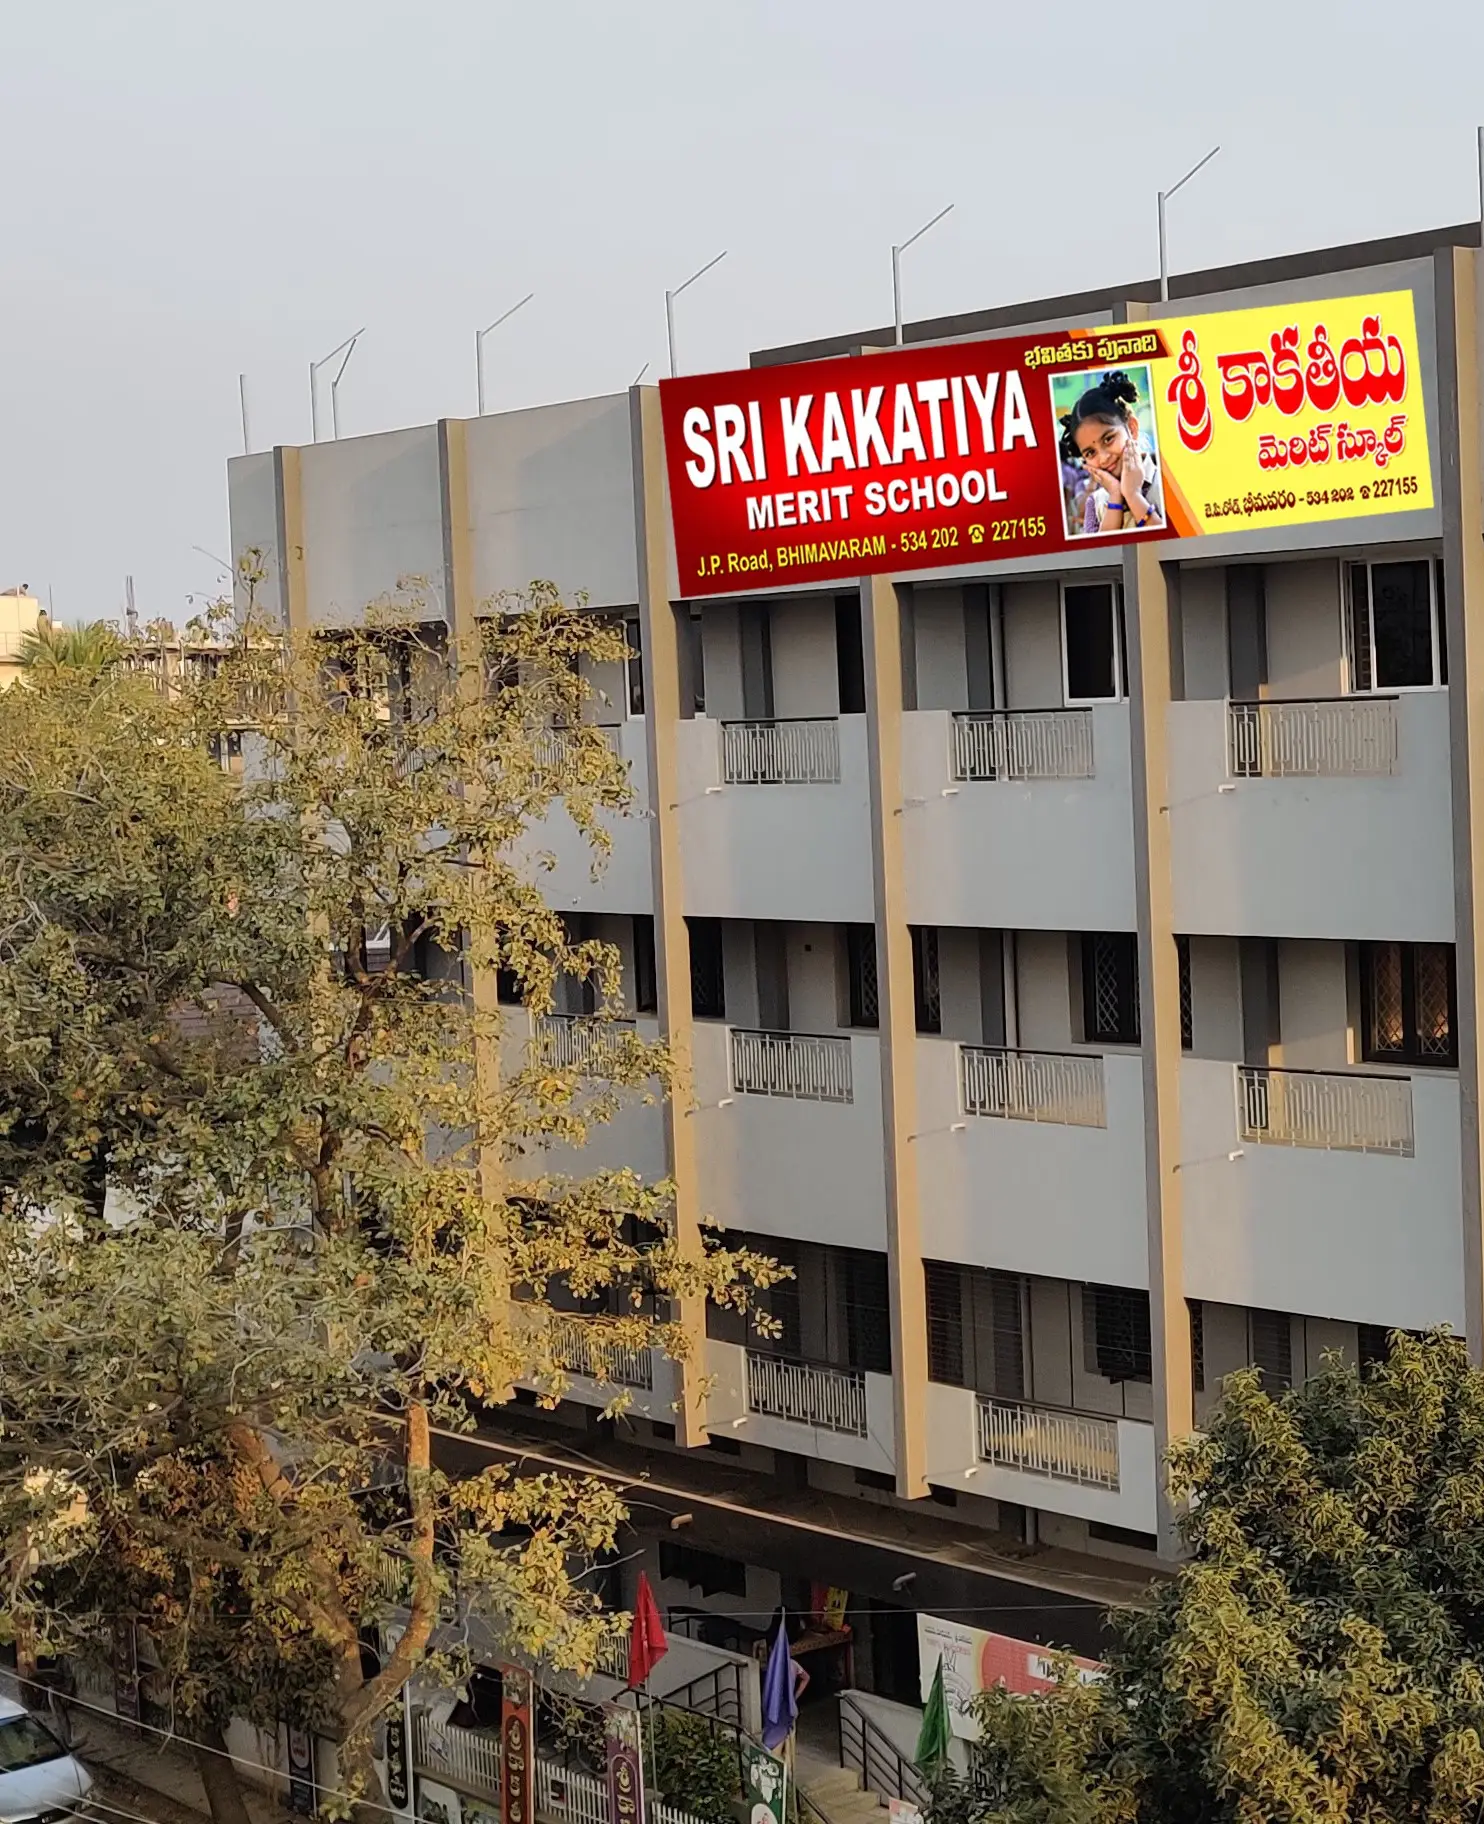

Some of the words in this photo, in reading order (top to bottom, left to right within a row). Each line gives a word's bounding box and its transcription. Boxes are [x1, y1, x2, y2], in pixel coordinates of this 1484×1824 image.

[1024, 340, 1094, 370] భవితకు
[1097, 334, 1158, 361] పునాది
[1167, 329, 1213, 452] శ్రీ
[1216, 315, 1407, 422] కాకతీయ
[683, 400, 767, 489] SRI
[780, 369, 1038, 475] KAKATIYA
[1257, 423, 1333, 470] మెరిట్
[1336, 415, 1407, 468] స్కూల్
[746, 485, 853, 531] MERIT
[865, 468, 1008, 516] SCHOOL
[1306, 490, 1329, 506] 534
[1330, 486, 1355, 503] 202
[1372, 476, 1418, 498] 227155
[697, 555, 724, 577] J.P.
[727, 548, 774, 574] Road,
[776, 535, 887, 568] BHIMAVARAM
[900, 530, 928, 552] 534
[931, 526, 959, 549] 202
[991, 516, 1047, 542] 227155
